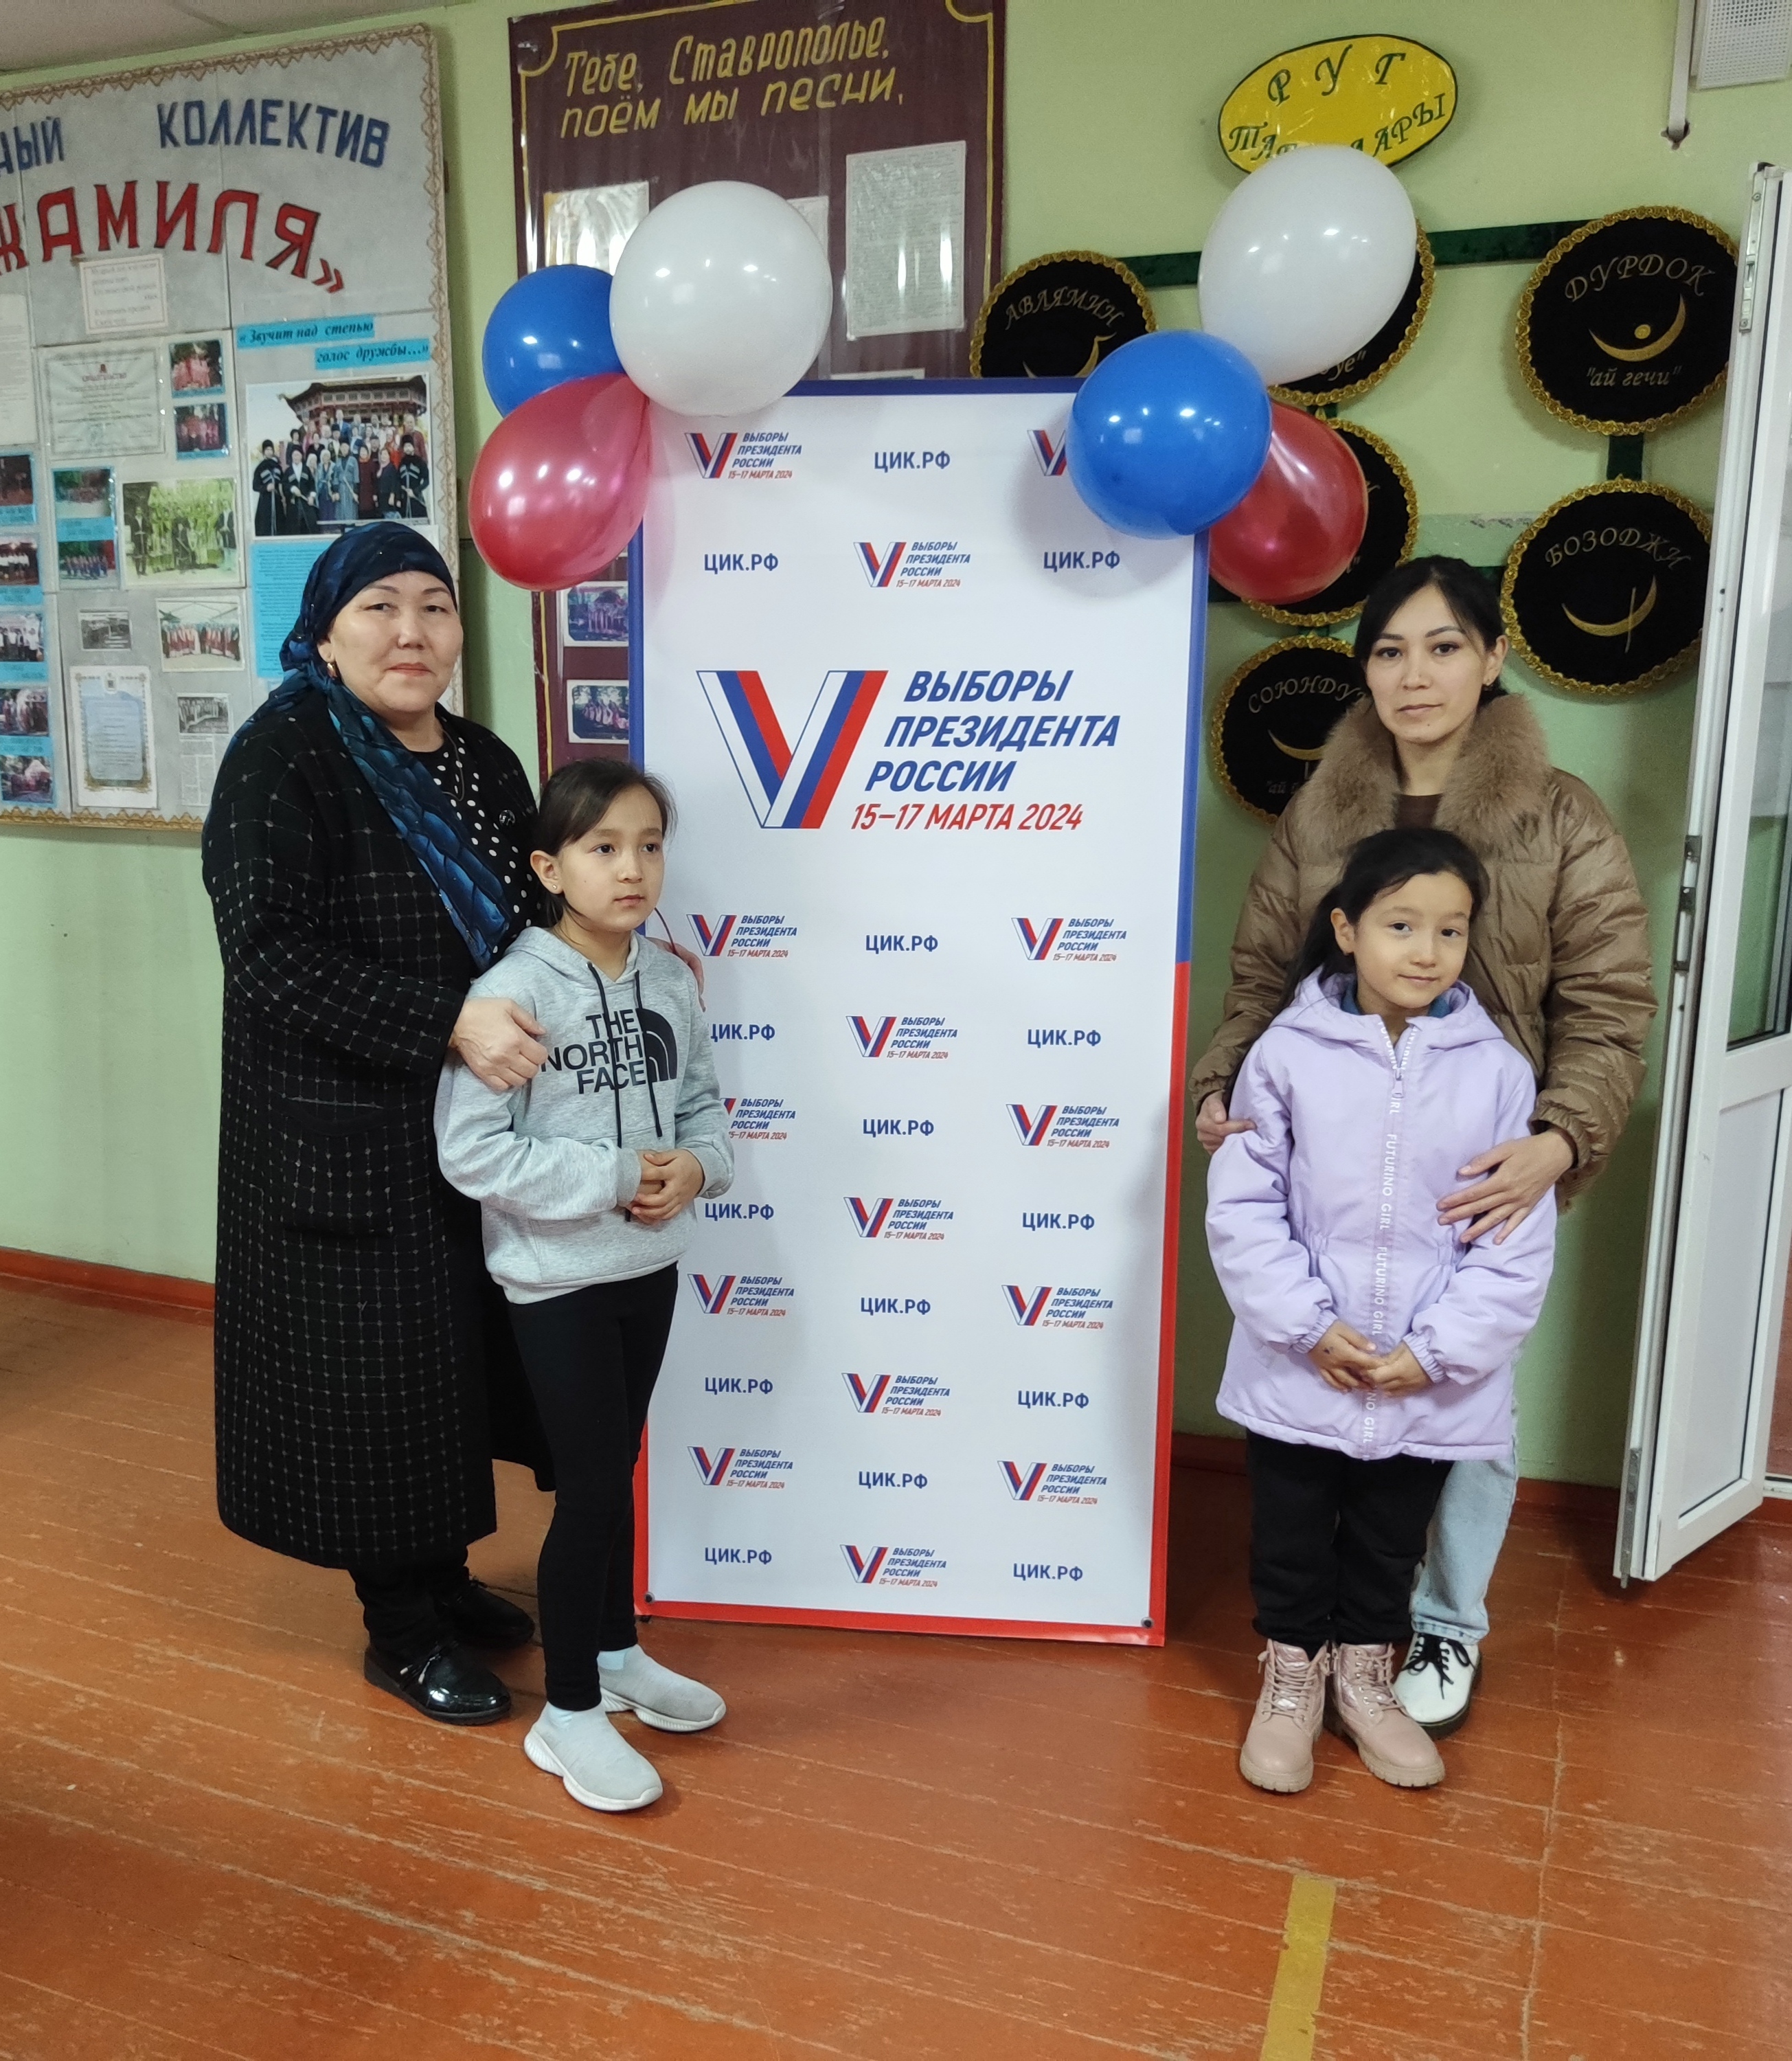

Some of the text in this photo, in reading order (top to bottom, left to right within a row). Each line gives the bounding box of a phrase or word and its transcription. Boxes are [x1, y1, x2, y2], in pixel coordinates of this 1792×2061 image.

[565, 52, 644, 96] Тебе,
[157, 98, 390, 168] КОЛЛЕКТИВ
[1565, 254, 1716, 302] ДУРДОК
[1005, 285, 1126, 330] АВЛЯМИН
[297, 324, 318, 338] над
[325, 322, 374, 336] степью
[317, 351, 350, 363] голос
[742, 431, 789, 442] ВЫБОРЫ
[737, 444, 802, 457] ПРЕЗИДЕНТА
[731, 458, 775, 469] РОССИИ
[874, 450, 951, 473] ЦИК.РФ
[748, 470, 774, 480] МАРТА
[911, 541, 958, 552] ВЫБОРЫ
[1545, 527, 1692, 570] БОЗОДЖИ
[704, 552, 779, 575] ЦИК.РФ
[905, 554, 971, 565] ПРЕЗИДЕНТА
[1043, 550, 1120, 574] ЦИК.РФ
[900, 566, 943, 577] РОССИИ
[916, 578, 942, 587] МАРТА
[903, 669, 1074, 703] ВЫБОРЫ
[1248, 675, 1367, 714] СОЮНДУ
[883, 714, 1121, 752] ПРЕЗИДЕНТА
[864, 760, 1018, 793] РОССИИ
[925, 803, 1014, 831] МАРТА
[1017, 803, 1084, 831] 2024
[740, 914, 786, 925] ВЫБОРЫ
[1067, 918, 1115, 928] ВЫБОРЫ
[736, 926, 797, 938] ПРЕЗИДЕНТА
[1062, 930, 1128, 941] ПРЕЗИДЕНТА
[730, 938, 771, 948] РОССИИ
[865, 934, 939, 955] ЦИК.РФ
[1056, 941, 1100, 951] РОССИИ
[746, 949, 771, 958] МАРТА
[1073, 953, 1099, 962] МАРТА
[585, 1009, 639, 1039] THE
[900, 1016, 946, 1026] ВЫБОРЫ
[895, 1028, 958, 1039] ПРЕЗИДЕНТА
[1027, 1028, 1102, 1049] ЦИК.РФ
[889, 1039, 931, 1049] РОССИИ
[541, 1034, 645, 1072] NORTH
[906, 1050, 931, 1059] МАРТА
[576, 1060, 646, 1094] FACE
[740, 1098, 784, 1108] ВЫБОРЫ
[735, 1109, 796, 1120] ПРЕЗИДЕНТА
[1061, 1105, 1108, 1116] ВЫБОРЫ
[730, 1120, 771, 1130] РОССИИ
[1056, 1116, 1120, 1128] ПРЕЗИДЕНТА
[863, 1118, 935, 1138] ЦИК.РФ
[1050, 1128, 1093, 1138] РОССИИ
[746, 1131, 771, 1140] МАРТА
[1066, 1139, 1092, 1148] МАРТА
[1379, 1134, 1398, 1230] FUTURINO GIRL
[897, 1198, 942, 1208] ВЫБОРЫ
[705, 1202, 775, 1222] ЦИК.РФ
[892, 1209, 954, 1221] ПРЕЗИДЕНТА
[887, 1220, 928, 1230] РОССИИ
[1022, 1212, 1096, 1232] ЦИК.РФ
[903, 1231, 927, 1240] МАРТА
[739, 1276, 783, 1285] ВЫБОРЫ
[734, 1286, 795, 1297] ПРЕЗИДЕНТА
[1056, 1287, 1102, 1297] ВЫБОРЫ
[1372, 1246, 1387, 1336] FUTURINO GIRL
[729, 1297, 769, 1307] РОССИИ
[860, 1296, 931, 1316] ЦИК.РФ
[1050, 1298, 1114, 1309] ПРЕЗИДЕНТА
[745, 1308, 769, 1316] МАРТА
[1045, 1309, 1087, 1319] РОССИИ
[1061, 1320, 1086, 1329] МАРТА
[894, 1375, 939, 1386] ВЫБОРЫ
[705, 1377, 773, 1396] ЦИК.РФ
[889, 1386, 951, 1397] ПРЕЗИДЕНТА
[885, 1396, 925, 1406] РОССИИ
[1017, 1390, 1089, 1410] ЦИК.РФ
[900, 1407, 925, 1416] МАРТА
[1363, 1417, 1374, 1443] GIRL
[739, 1448, 782, 1459] ВЫБОРЫ
[734, 1459, 793, 1470] ПРЕЗИДЕНТА
[1051, 1463, 1096, 1474] ВЫБОРЫ
[729, 1469, 769, 1479] РОССИИ
[1045, 1474, 1108, 1485] ПРЕЗИДЕНТА
[745, 1480, 769, 1489] МАРТА
[858, 1471, 928, 1489] ЦИК.РФ
[1040, 1484, 1081, 1495] РОССИИ
[1056, 1496, 1080, 1504] МАРТА
[704, 1546, 773, 1566] ЦИК.РФ
[892, 1547, 935, 1557] ВЫБОРЫ
[887, 1557, 947, 1569] ПРЕЗИДЕНТА
[882, 1568, 922, 1577] РОССИИ
[1012, 1562, 1084, 1581] ЦИК.РФ
[897, 1579, 921, 1587] МАРТА
